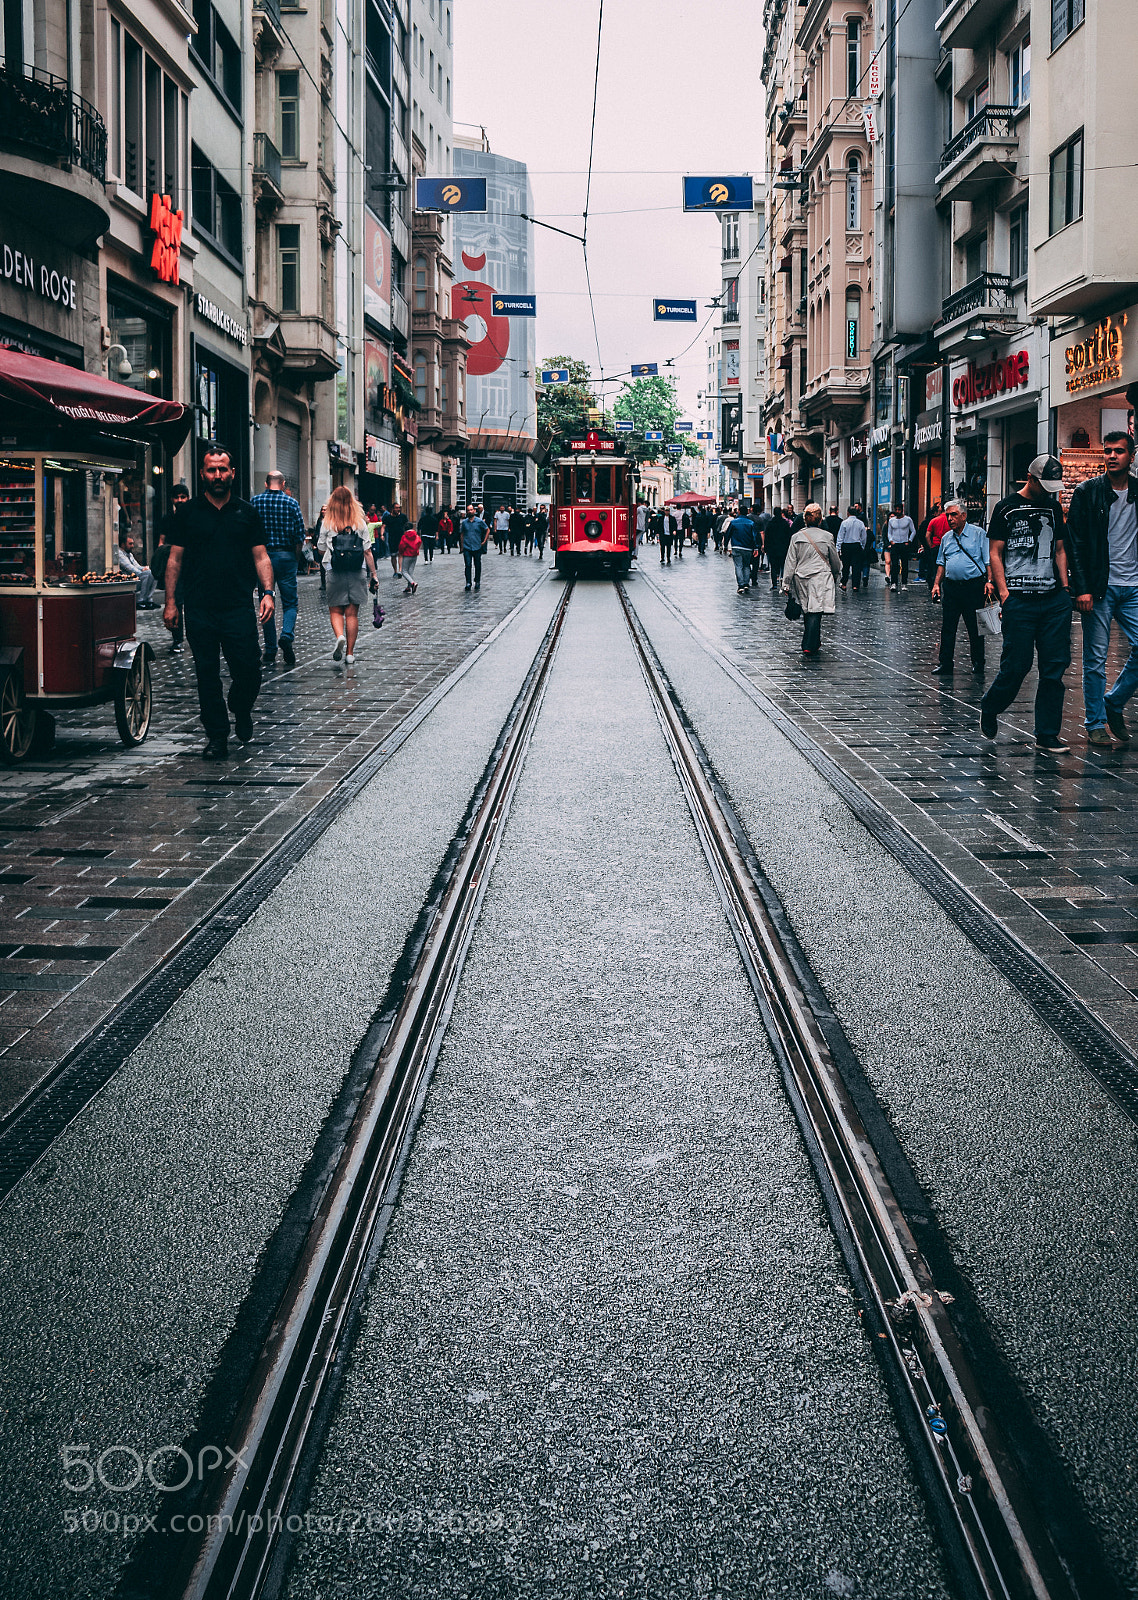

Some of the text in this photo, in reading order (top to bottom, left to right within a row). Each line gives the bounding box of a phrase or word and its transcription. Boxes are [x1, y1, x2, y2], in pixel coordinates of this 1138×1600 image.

[0, 244, 77, 310] DEN ROSE
[198, 293, 248, 346] STARBUCKS COFFEE
[952, 350, 1029, 407] collezione
[589, 432, 595, 441] 4
